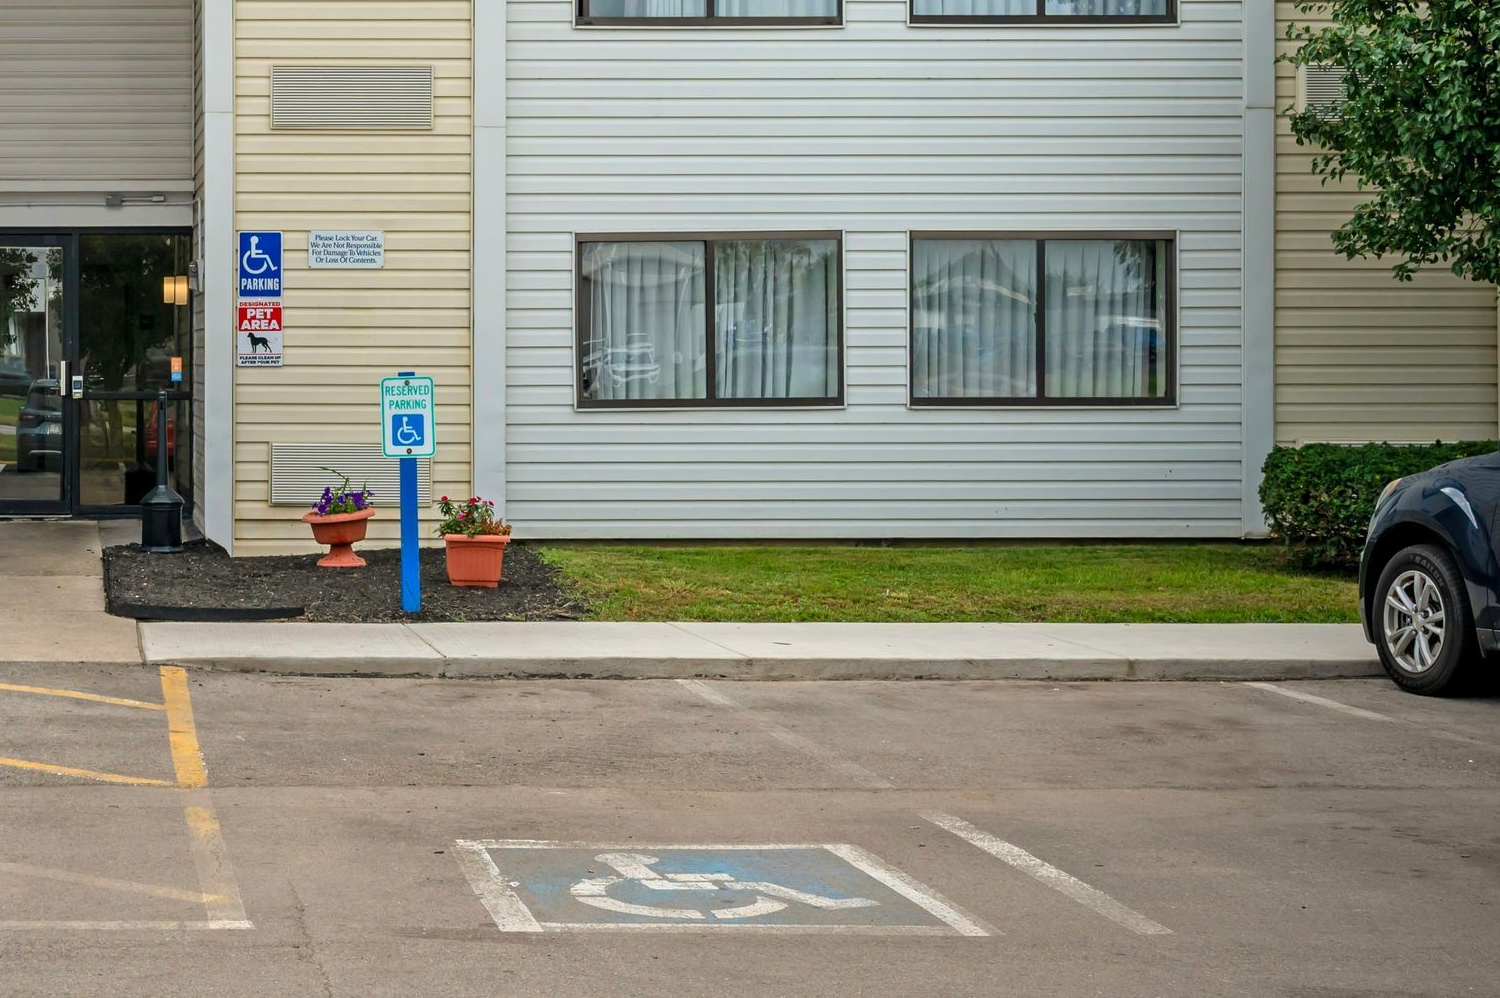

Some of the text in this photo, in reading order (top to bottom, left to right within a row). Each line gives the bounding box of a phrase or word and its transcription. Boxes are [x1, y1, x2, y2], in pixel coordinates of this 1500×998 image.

[346, 242, 382, 250] Responsible
[241, 278, 280, 291] PARKING
[247, 309, 274, 318] PET
[240, 320, 280, 330] AREA
[385, 385, 430, 396] RESERVED
[389, 399, 427, 410] PARKING
